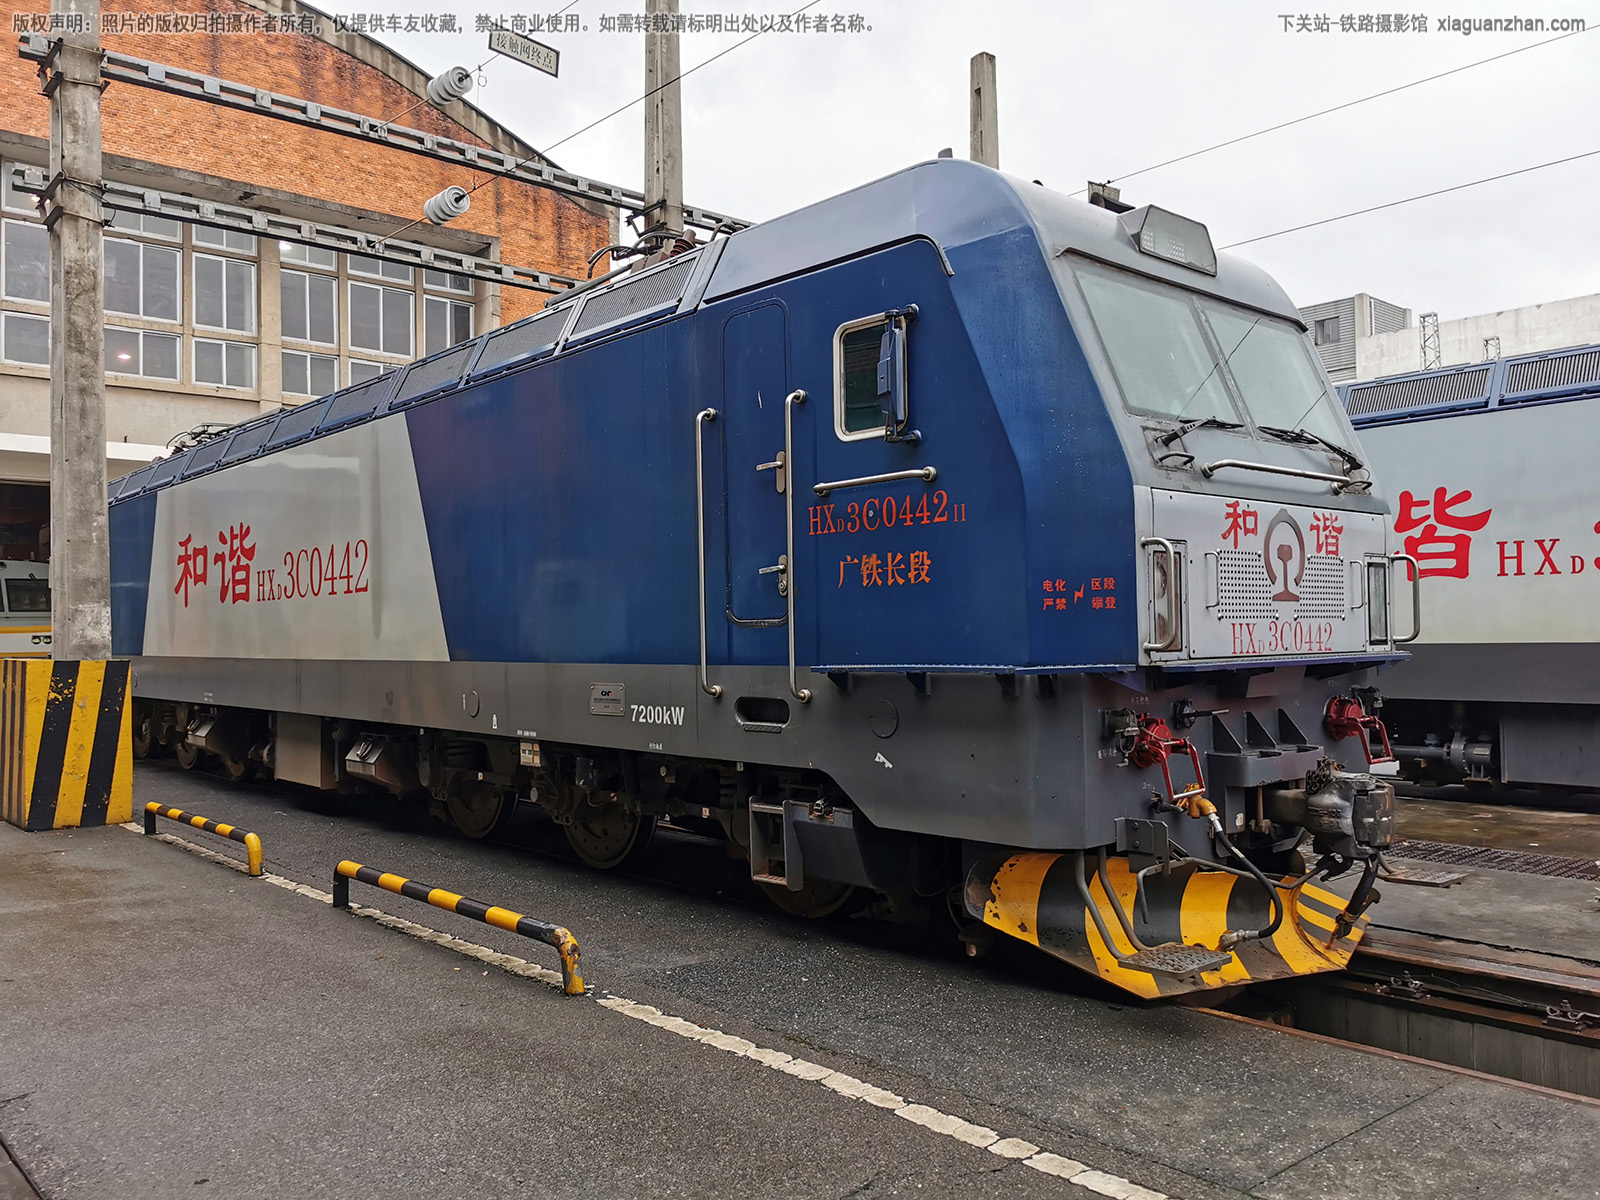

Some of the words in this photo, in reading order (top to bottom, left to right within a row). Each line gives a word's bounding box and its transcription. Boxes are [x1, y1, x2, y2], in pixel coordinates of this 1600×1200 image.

[496, 32, 553, 70] 接触网终点
[174, 521, 256, 608] 和谐
[1496, 519, 1600, 577] HXD
[838, 550, 932, 589] 广铁长段
[1042, 579, 1067, 592] 电化
[1091, 577, 1116, 590] 区段
[1042, 598, 1067, 611] 严禁
[1091, 597, 1117, 610] 攀登
[630, 704, 685, 726] 7200kW
